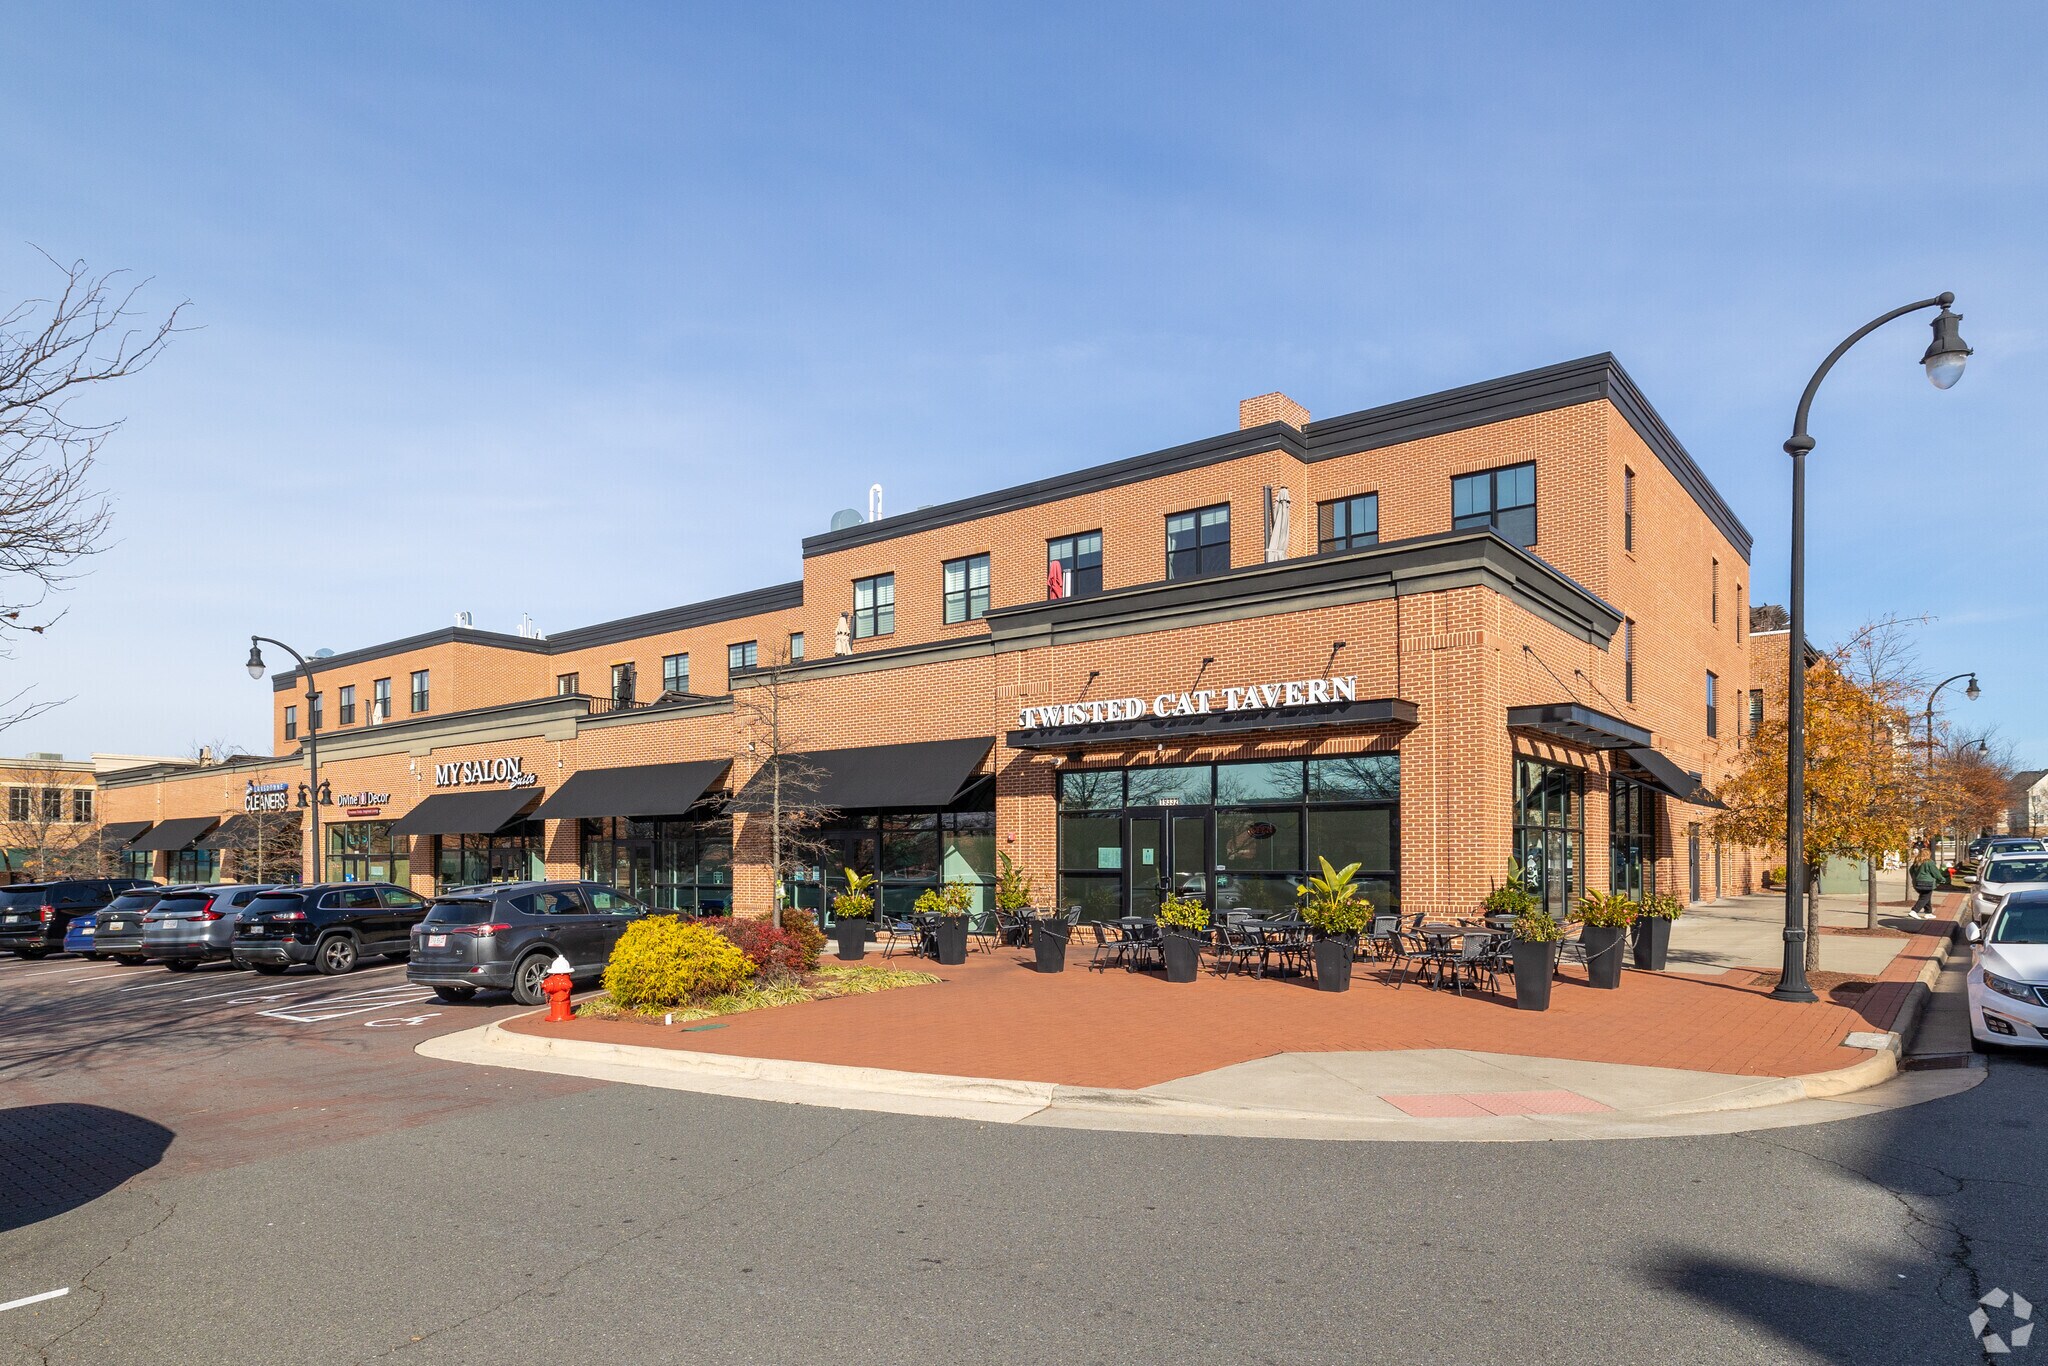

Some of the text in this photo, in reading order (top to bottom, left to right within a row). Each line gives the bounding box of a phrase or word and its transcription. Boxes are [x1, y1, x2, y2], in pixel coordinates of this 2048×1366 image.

[1021, 675, 1357, 729] TWISTED CAT TAVERN
[435, 757, 520, 785] MY SALON
[510, 772, 535, 789] Suite
[245, 793, 285, 811] CLEANERS
[368, 792, 389, 804] Decor
